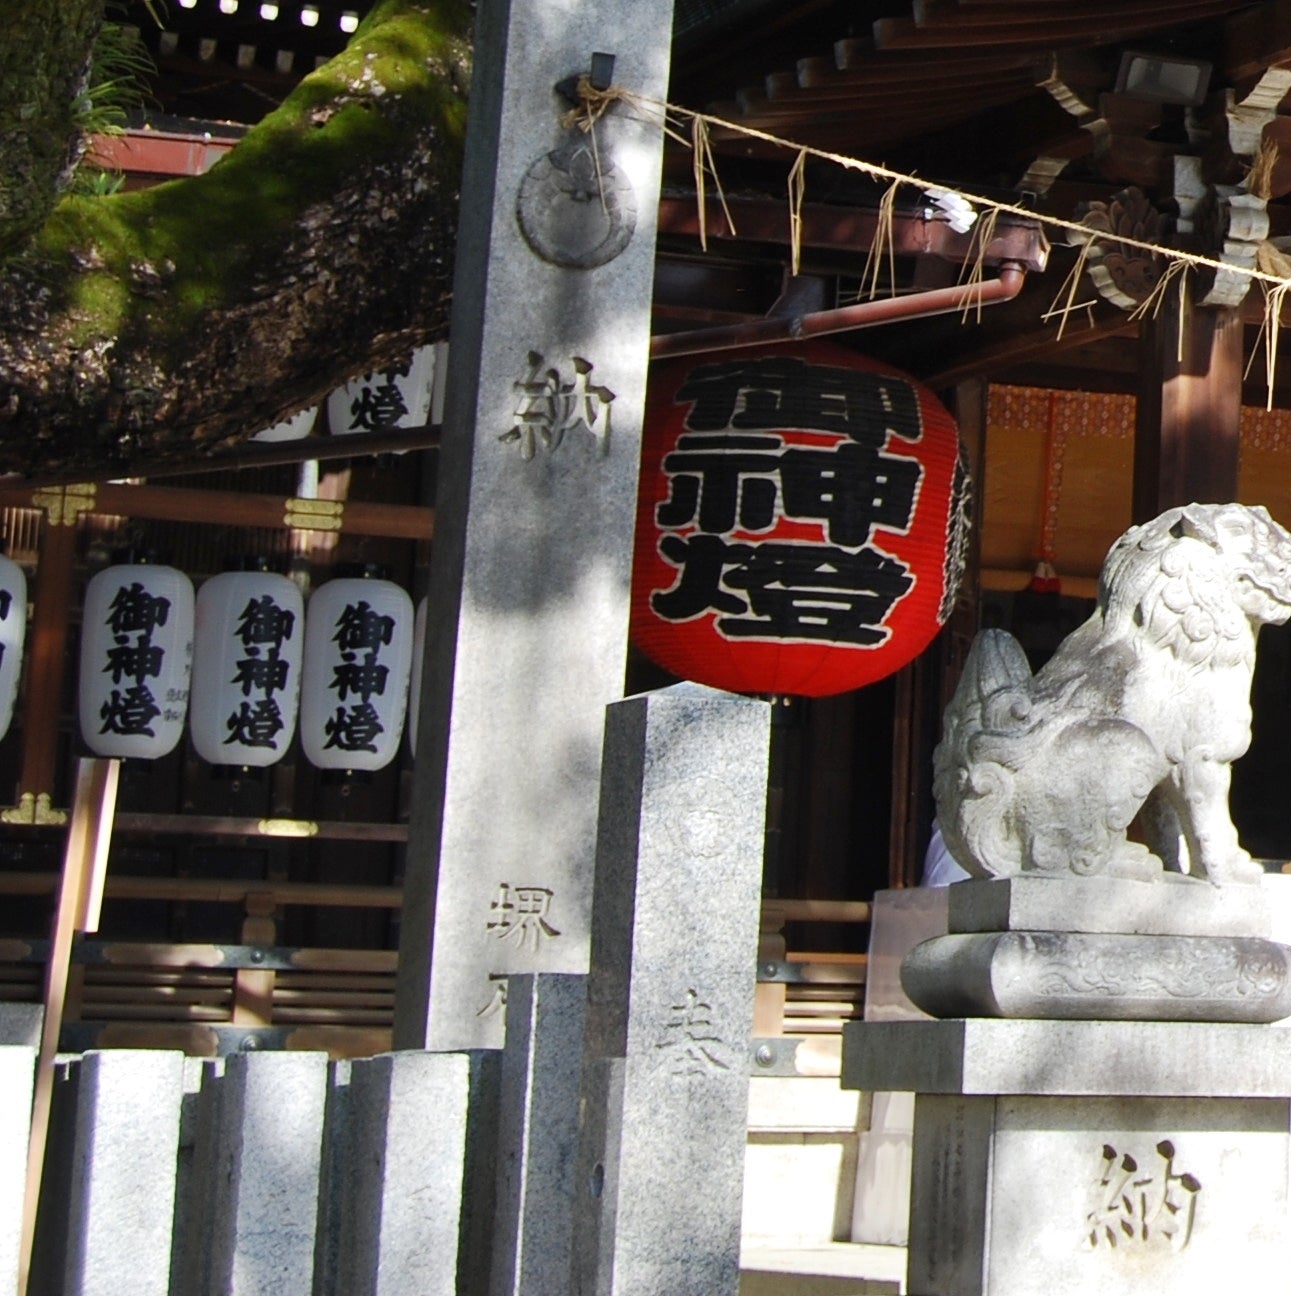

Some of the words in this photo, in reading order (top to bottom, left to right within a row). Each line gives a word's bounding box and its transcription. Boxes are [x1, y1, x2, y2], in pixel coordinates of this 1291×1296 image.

[499, 350, 617, 462] 納
[649, 355, 924, 650] 御神燈
[98, 582, 172, 738] 御神燈
[221, 594, 296, 750] 御神燈
[322, 600, 396, 754] 御神燈
[653, 988, 731, 1090] 奉
[1083, 1139, 1202, 1251] 納
